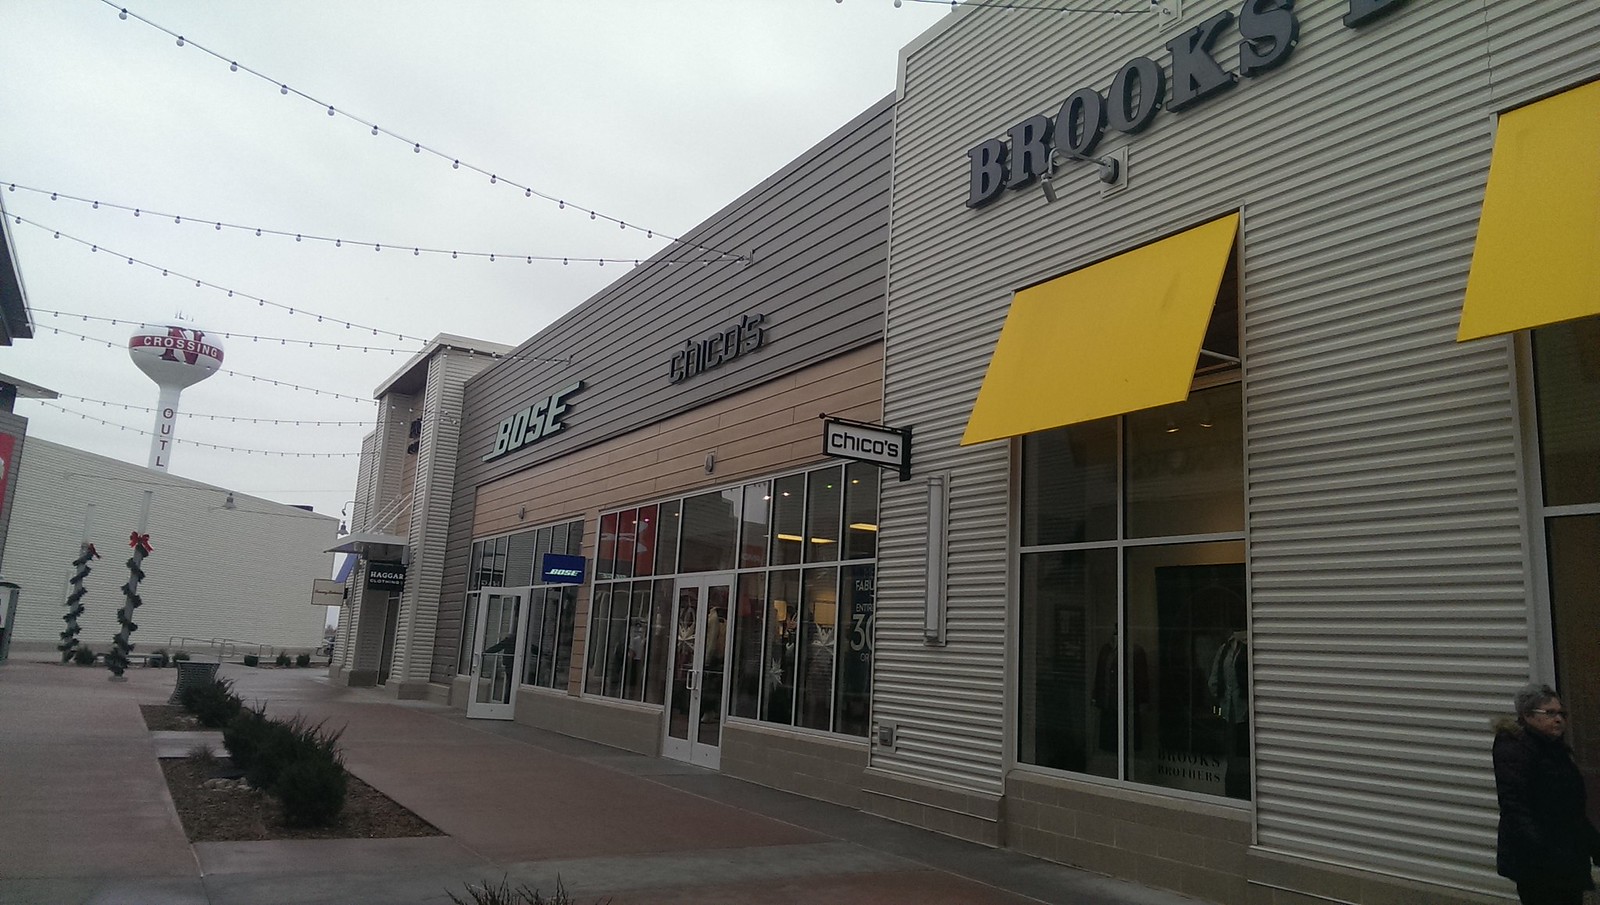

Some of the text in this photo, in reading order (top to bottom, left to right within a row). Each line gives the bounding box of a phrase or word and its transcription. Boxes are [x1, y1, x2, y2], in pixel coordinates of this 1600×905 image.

[966, 0, 1299, 208] BROOKS
[143, 336, 218, 358] CROSSING
[159, 325, 206, 365] N
[668, 313, 764, 385] chico's
[482, 380, 584, 463] BOSE
[831, 432, 899, 457] chico's
[370, 571, 404, 580] HAGGAR
[545, 568, 582, 577] BOSE
[1158, 765, 1221, 783] BROTHERS
